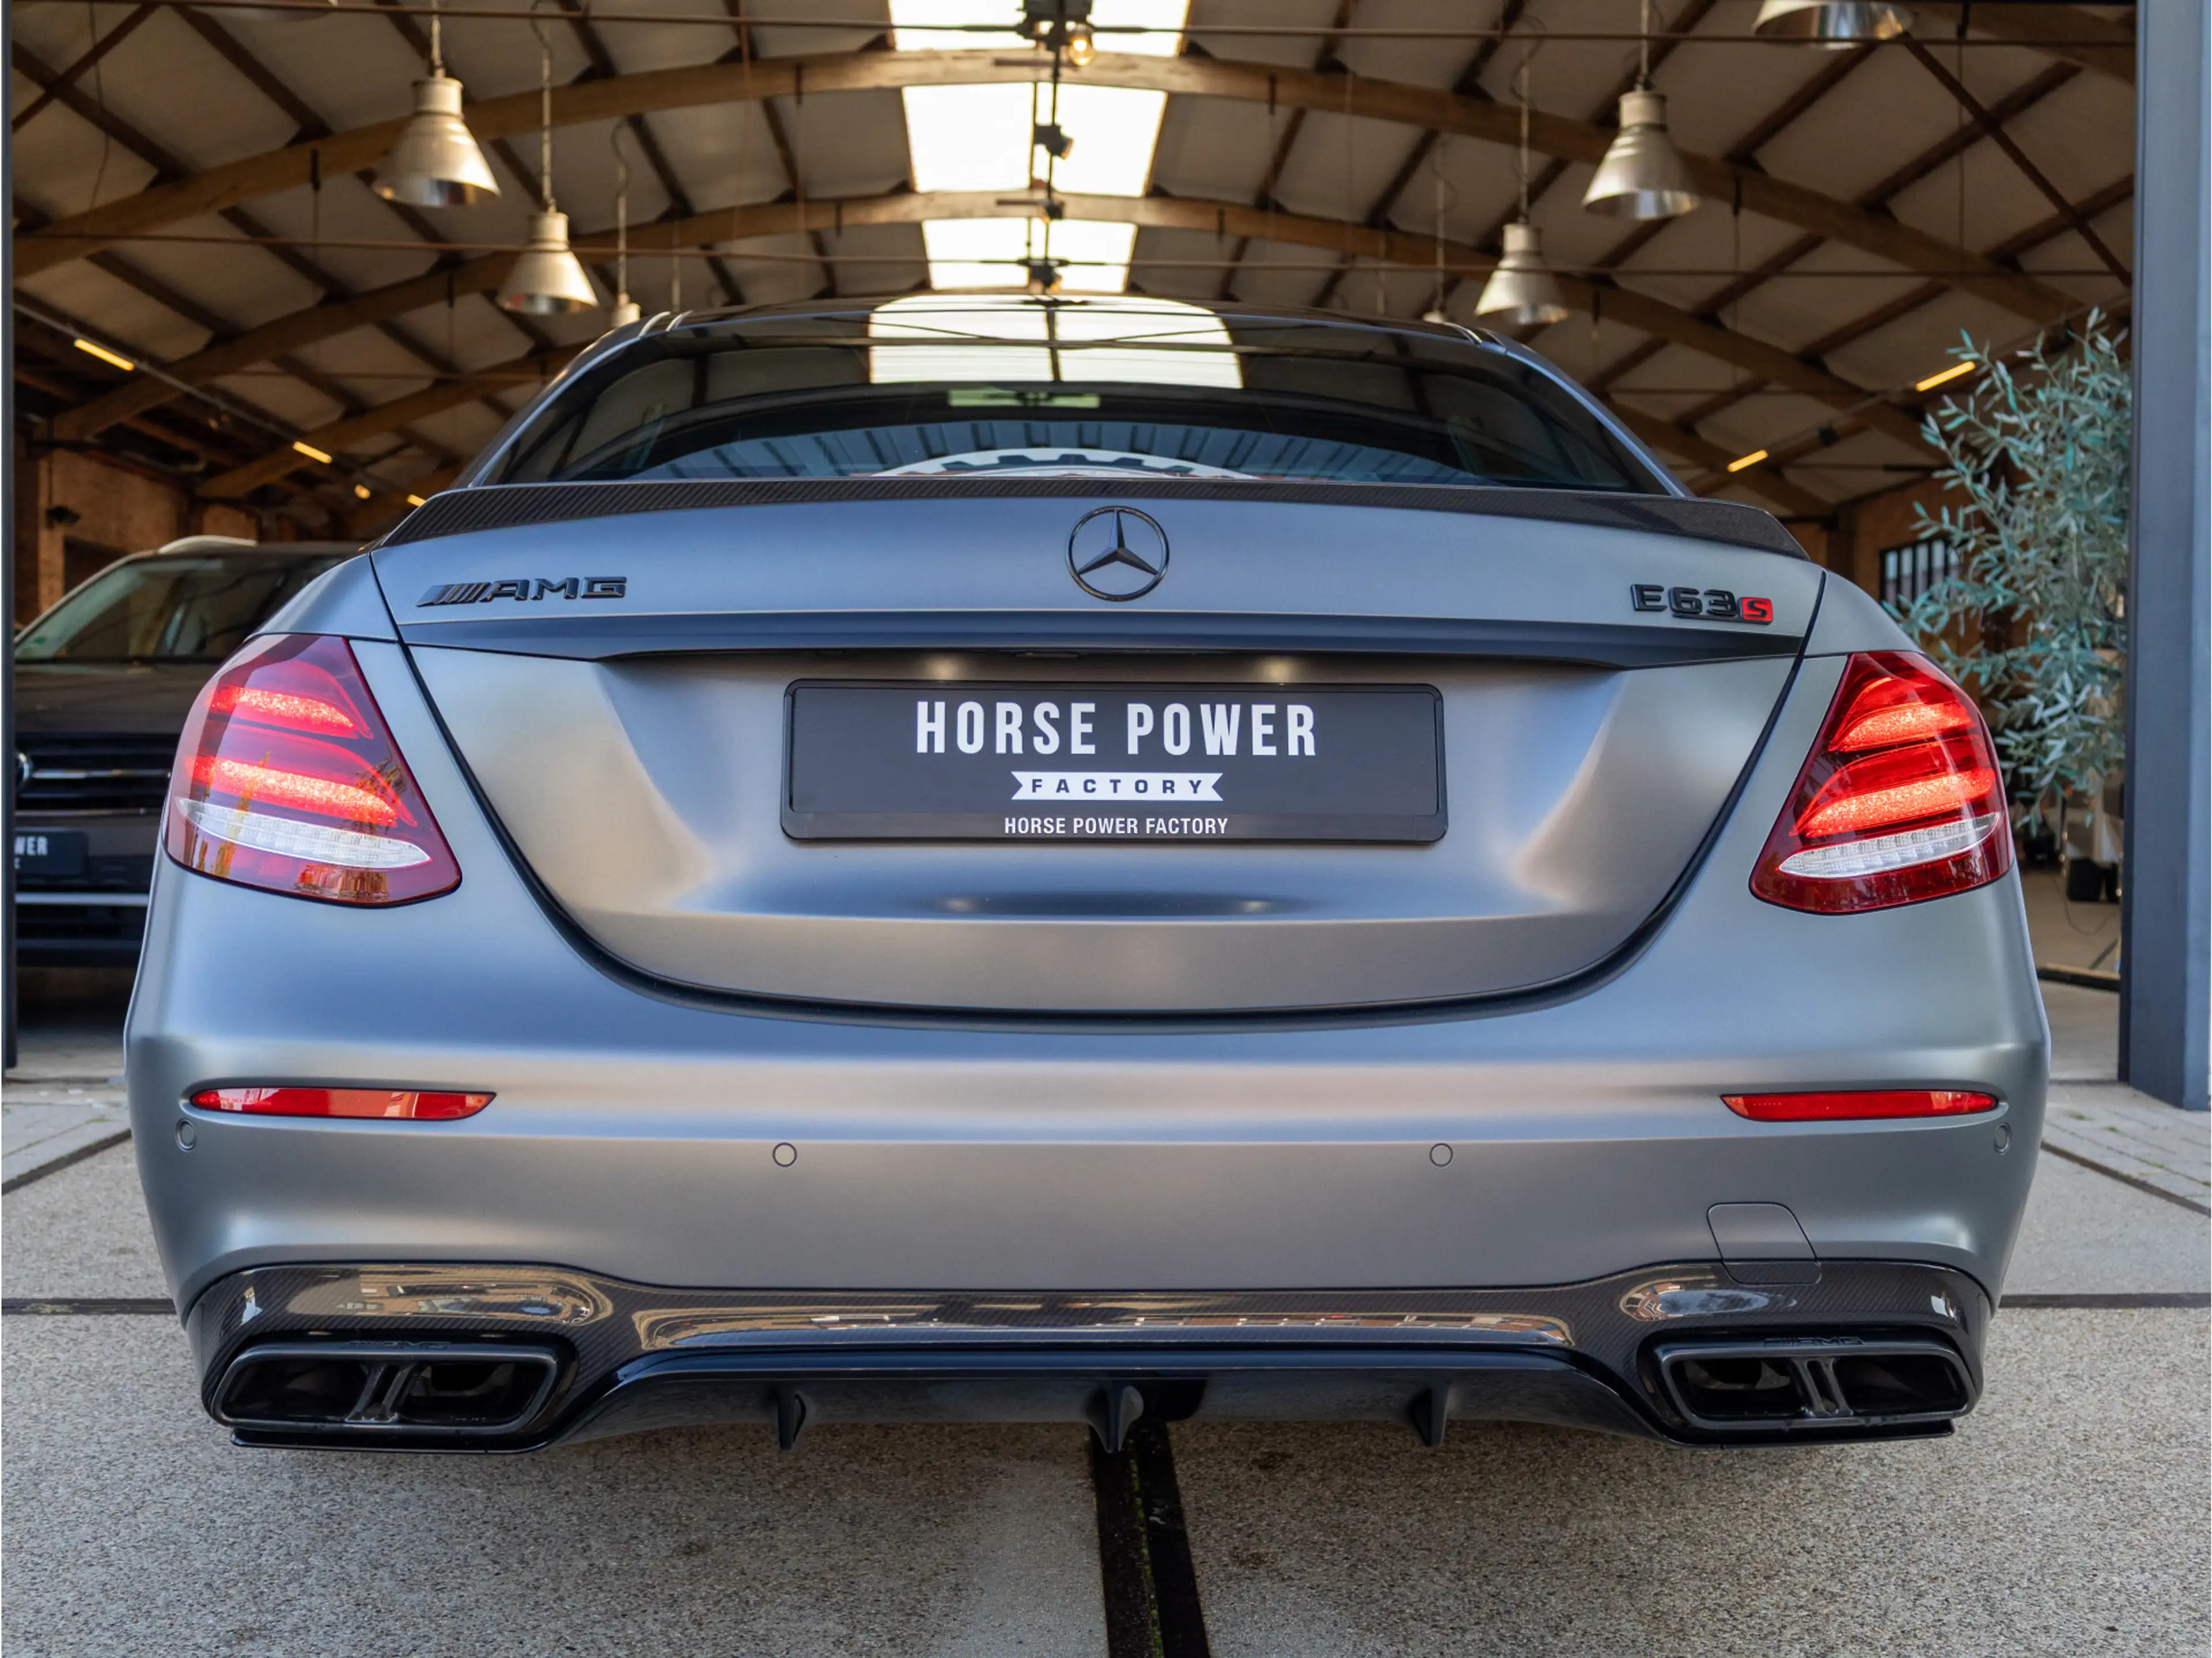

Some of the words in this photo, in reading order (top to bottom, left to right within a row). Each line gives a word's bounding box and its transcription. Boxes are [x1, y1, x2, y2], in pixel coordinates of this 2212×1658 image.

[478, 576, 627, 603] AMG
[916, 701, 1096, 755] HORSE
[1127, 702, 1317, 756] POWER
[1031, 778, 1205, 794] FACTORY
[1004, 816, 1067, 835] HORSE
[1073, 816, 1139, 835] POWER
[1145, 817, 1229, 835] FACTORY
